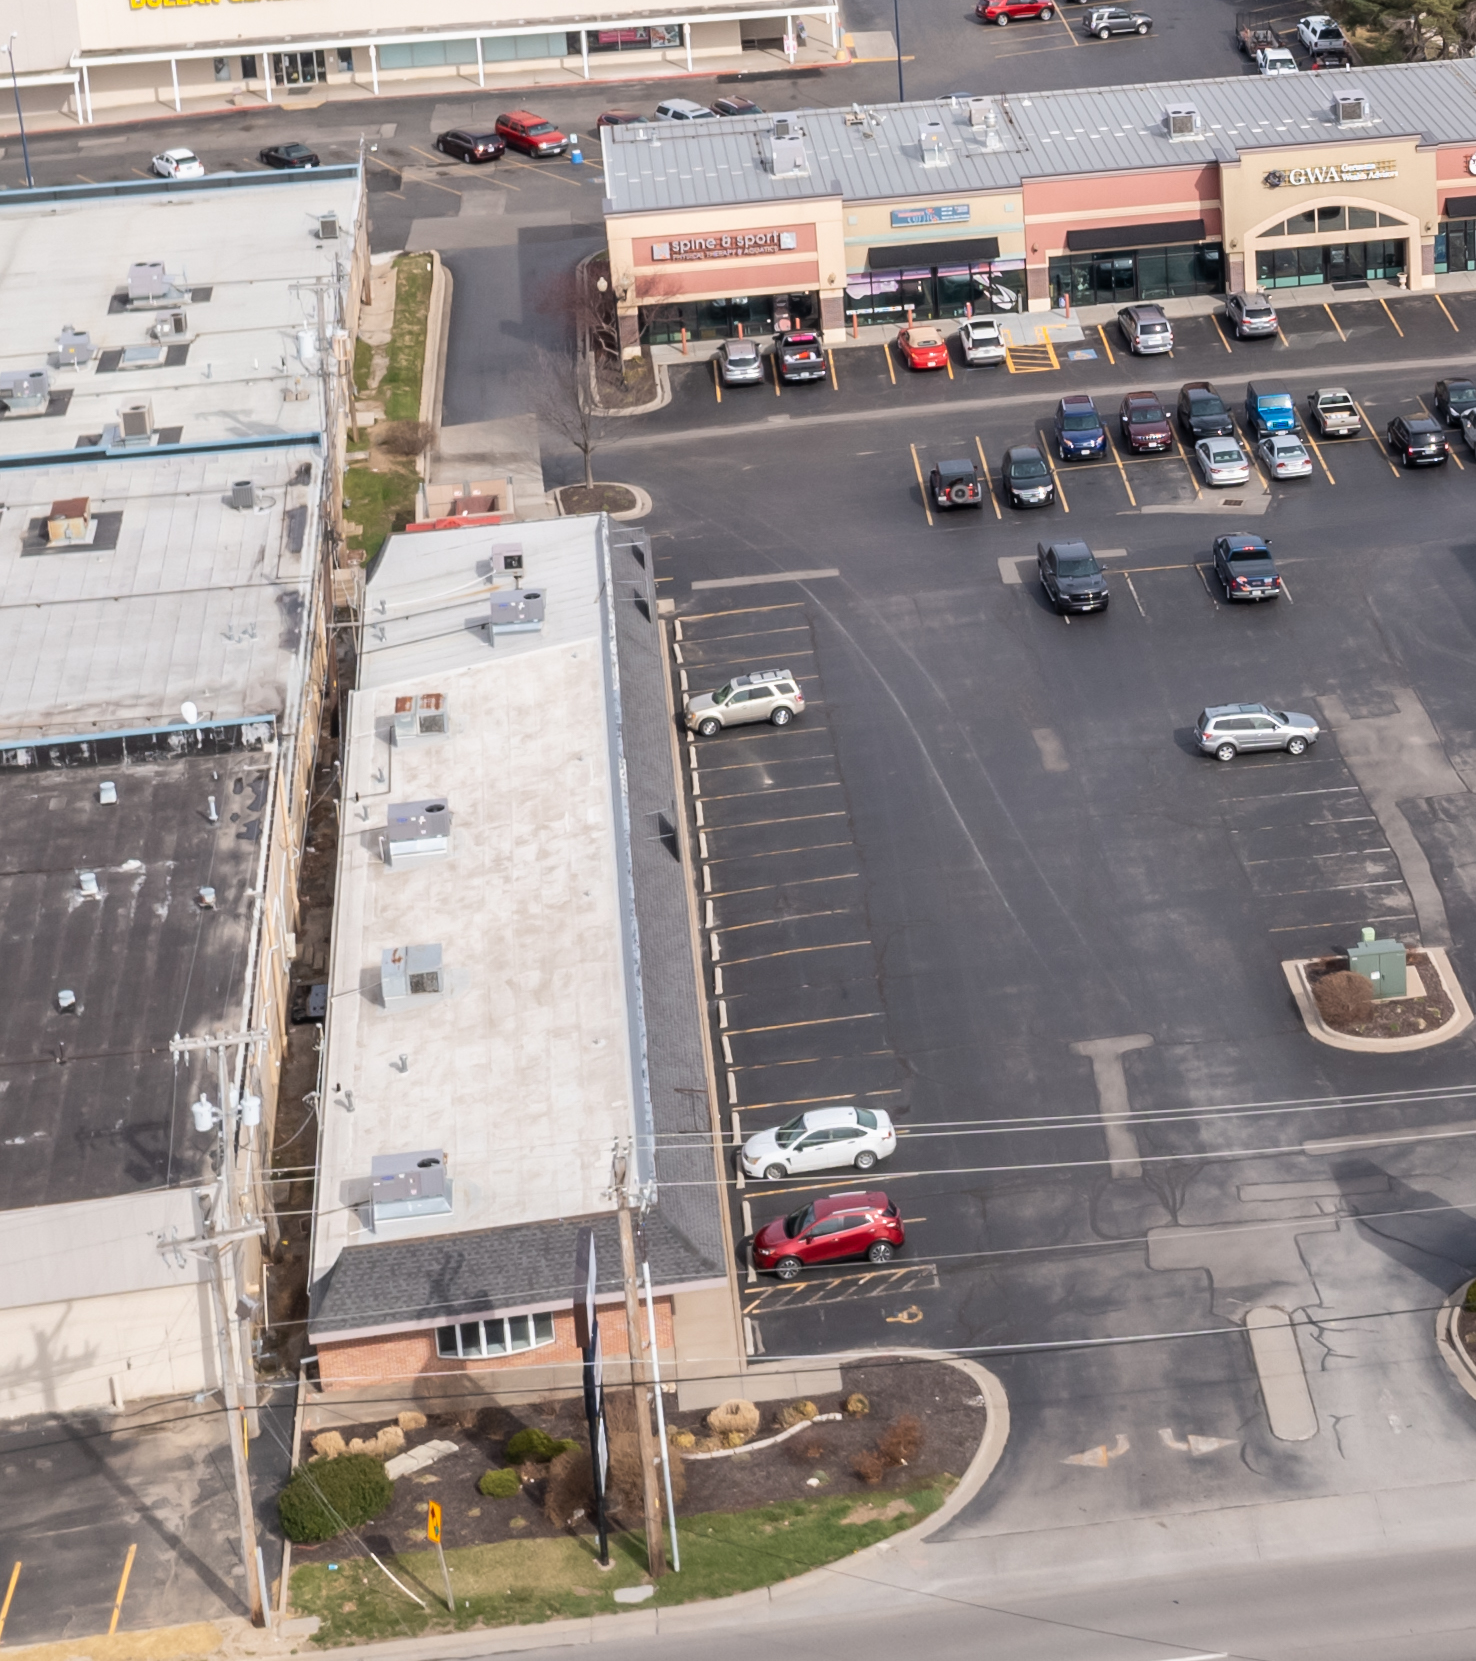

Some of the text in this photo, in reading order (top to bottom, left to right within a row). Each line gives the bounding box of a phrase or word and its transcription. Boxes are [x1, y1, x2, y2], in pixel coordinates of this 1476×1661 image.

[1289, 166, 1341, 186] GWA
[672, 237, 717, 254] spine
[736, 230, 780, 250] sport
[672, 251, 705, 261] PHYSICAL
[706, 248, 736, 258] THERAPY
[743, 245, 779, 255] AQUATICS
